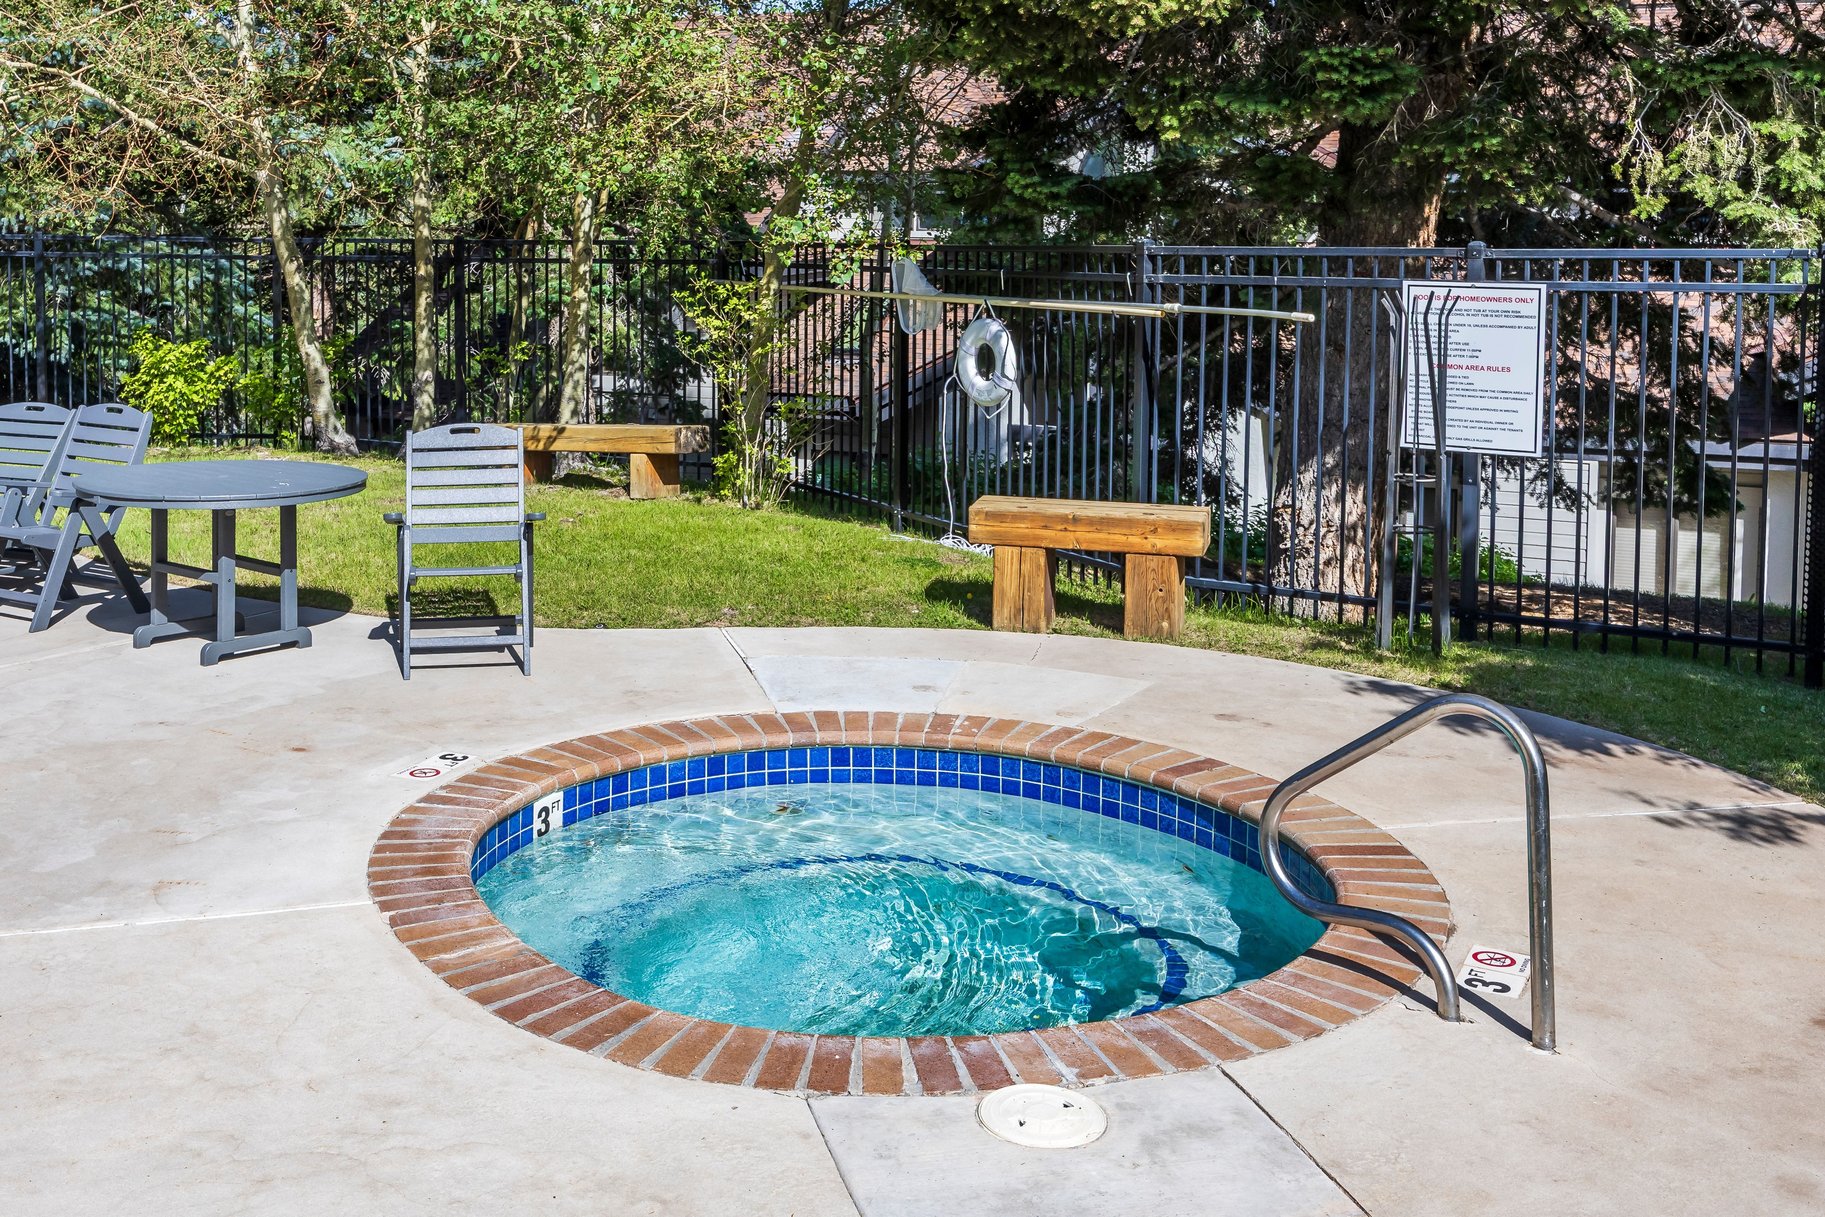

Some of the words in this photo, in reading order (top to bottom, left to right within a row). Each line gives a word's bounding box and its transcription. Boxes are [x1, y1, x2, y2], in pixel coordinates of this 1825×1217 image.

[439, 753, 469, 762] 3
[536, 806, 550, 838] 3
[552, 800, 560, 814] FT
[1468, 968, 1486, 978] FT
[1464, 978, 1511, 994] 3
